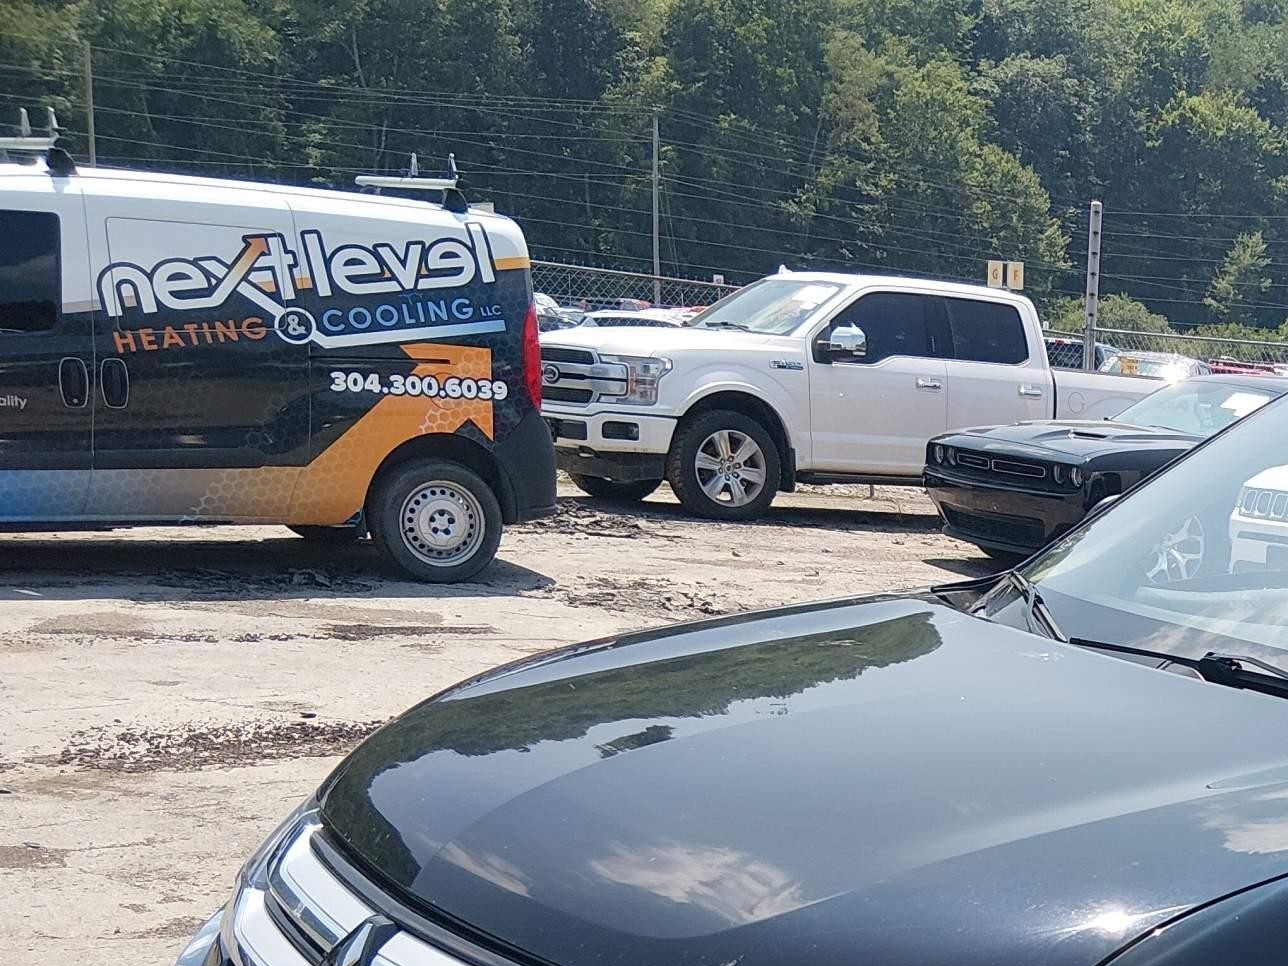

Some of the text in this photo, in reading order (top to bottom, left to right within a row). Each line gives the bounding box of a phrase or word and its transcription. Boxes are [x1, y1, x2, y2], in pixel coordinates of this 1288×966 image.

[112, 298, 502, 354] HEATING & COOLING LLC
[330, 371, 508, 400] 304.300.6039
